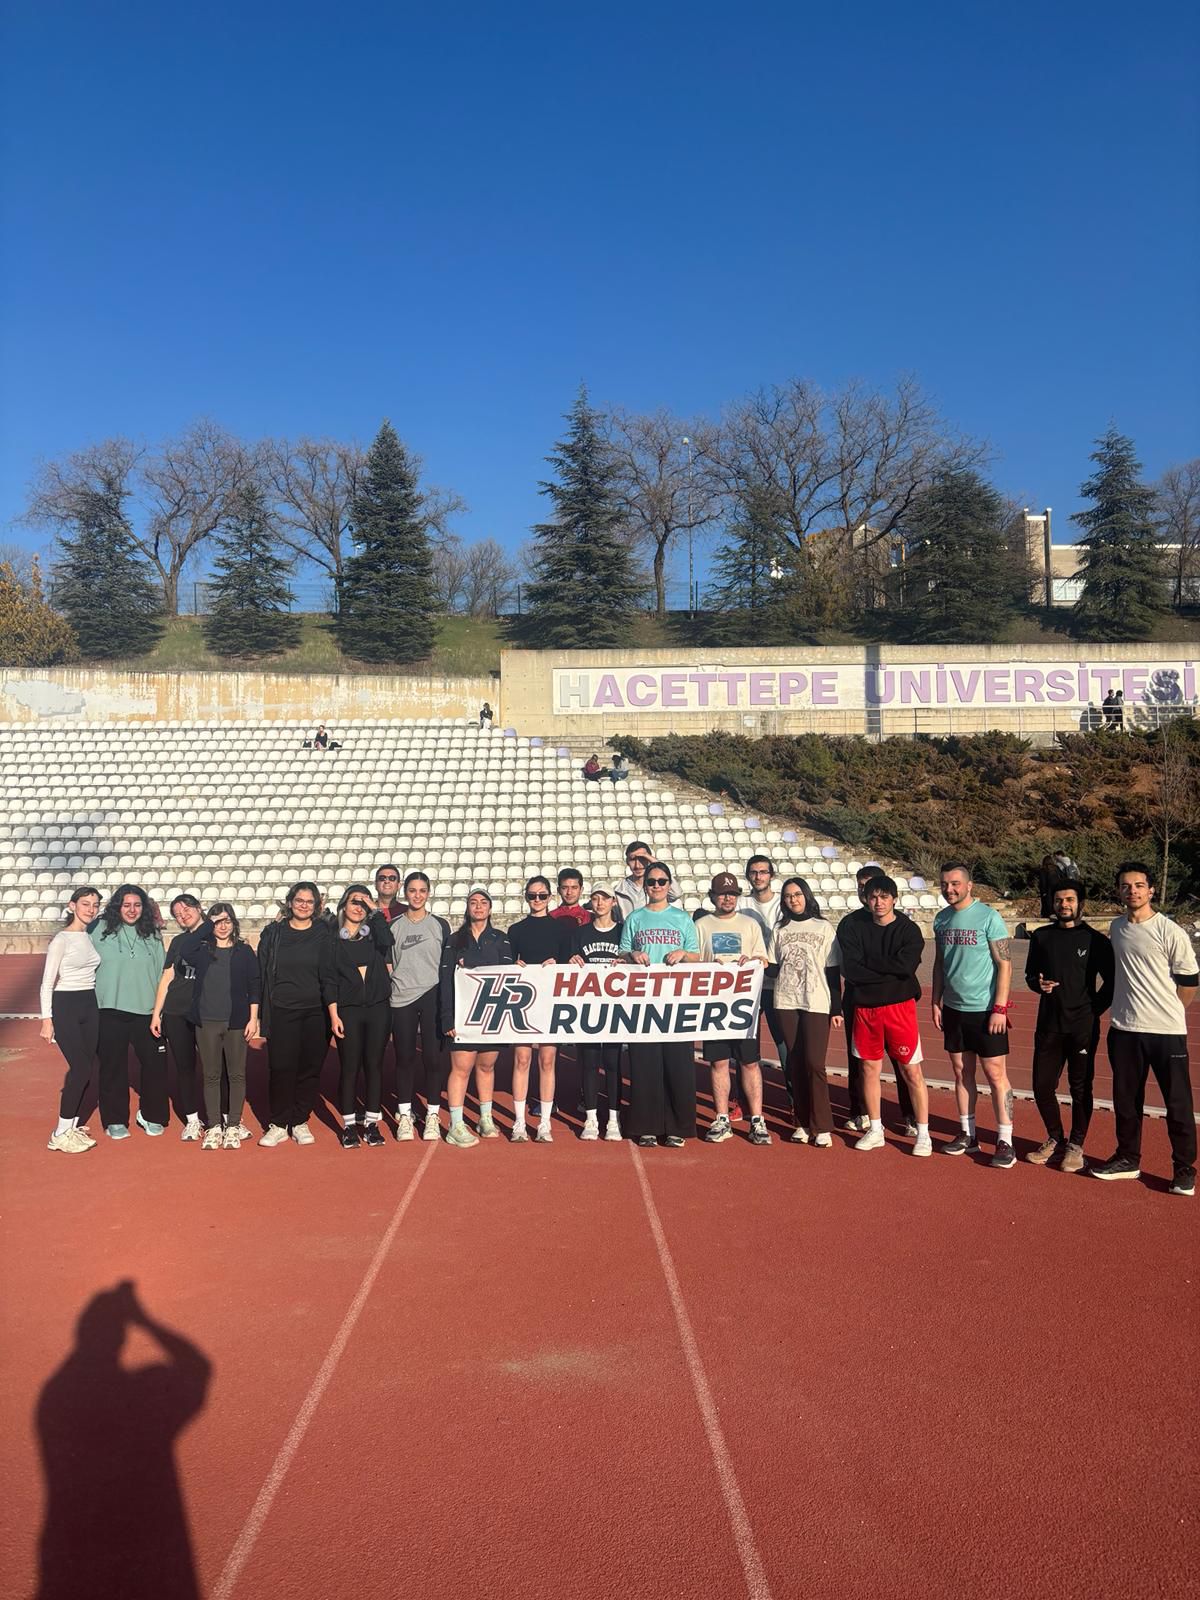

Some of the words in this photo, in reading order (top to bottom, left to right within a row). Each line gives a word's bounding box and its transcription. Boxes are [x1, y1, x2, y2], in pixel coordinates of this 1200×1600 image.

[559, 671, 839, 707] HACETTEPE
[552, 968, 756, 998] HACETTEPE
[549, 998, 755, 1034] RUNNERS
